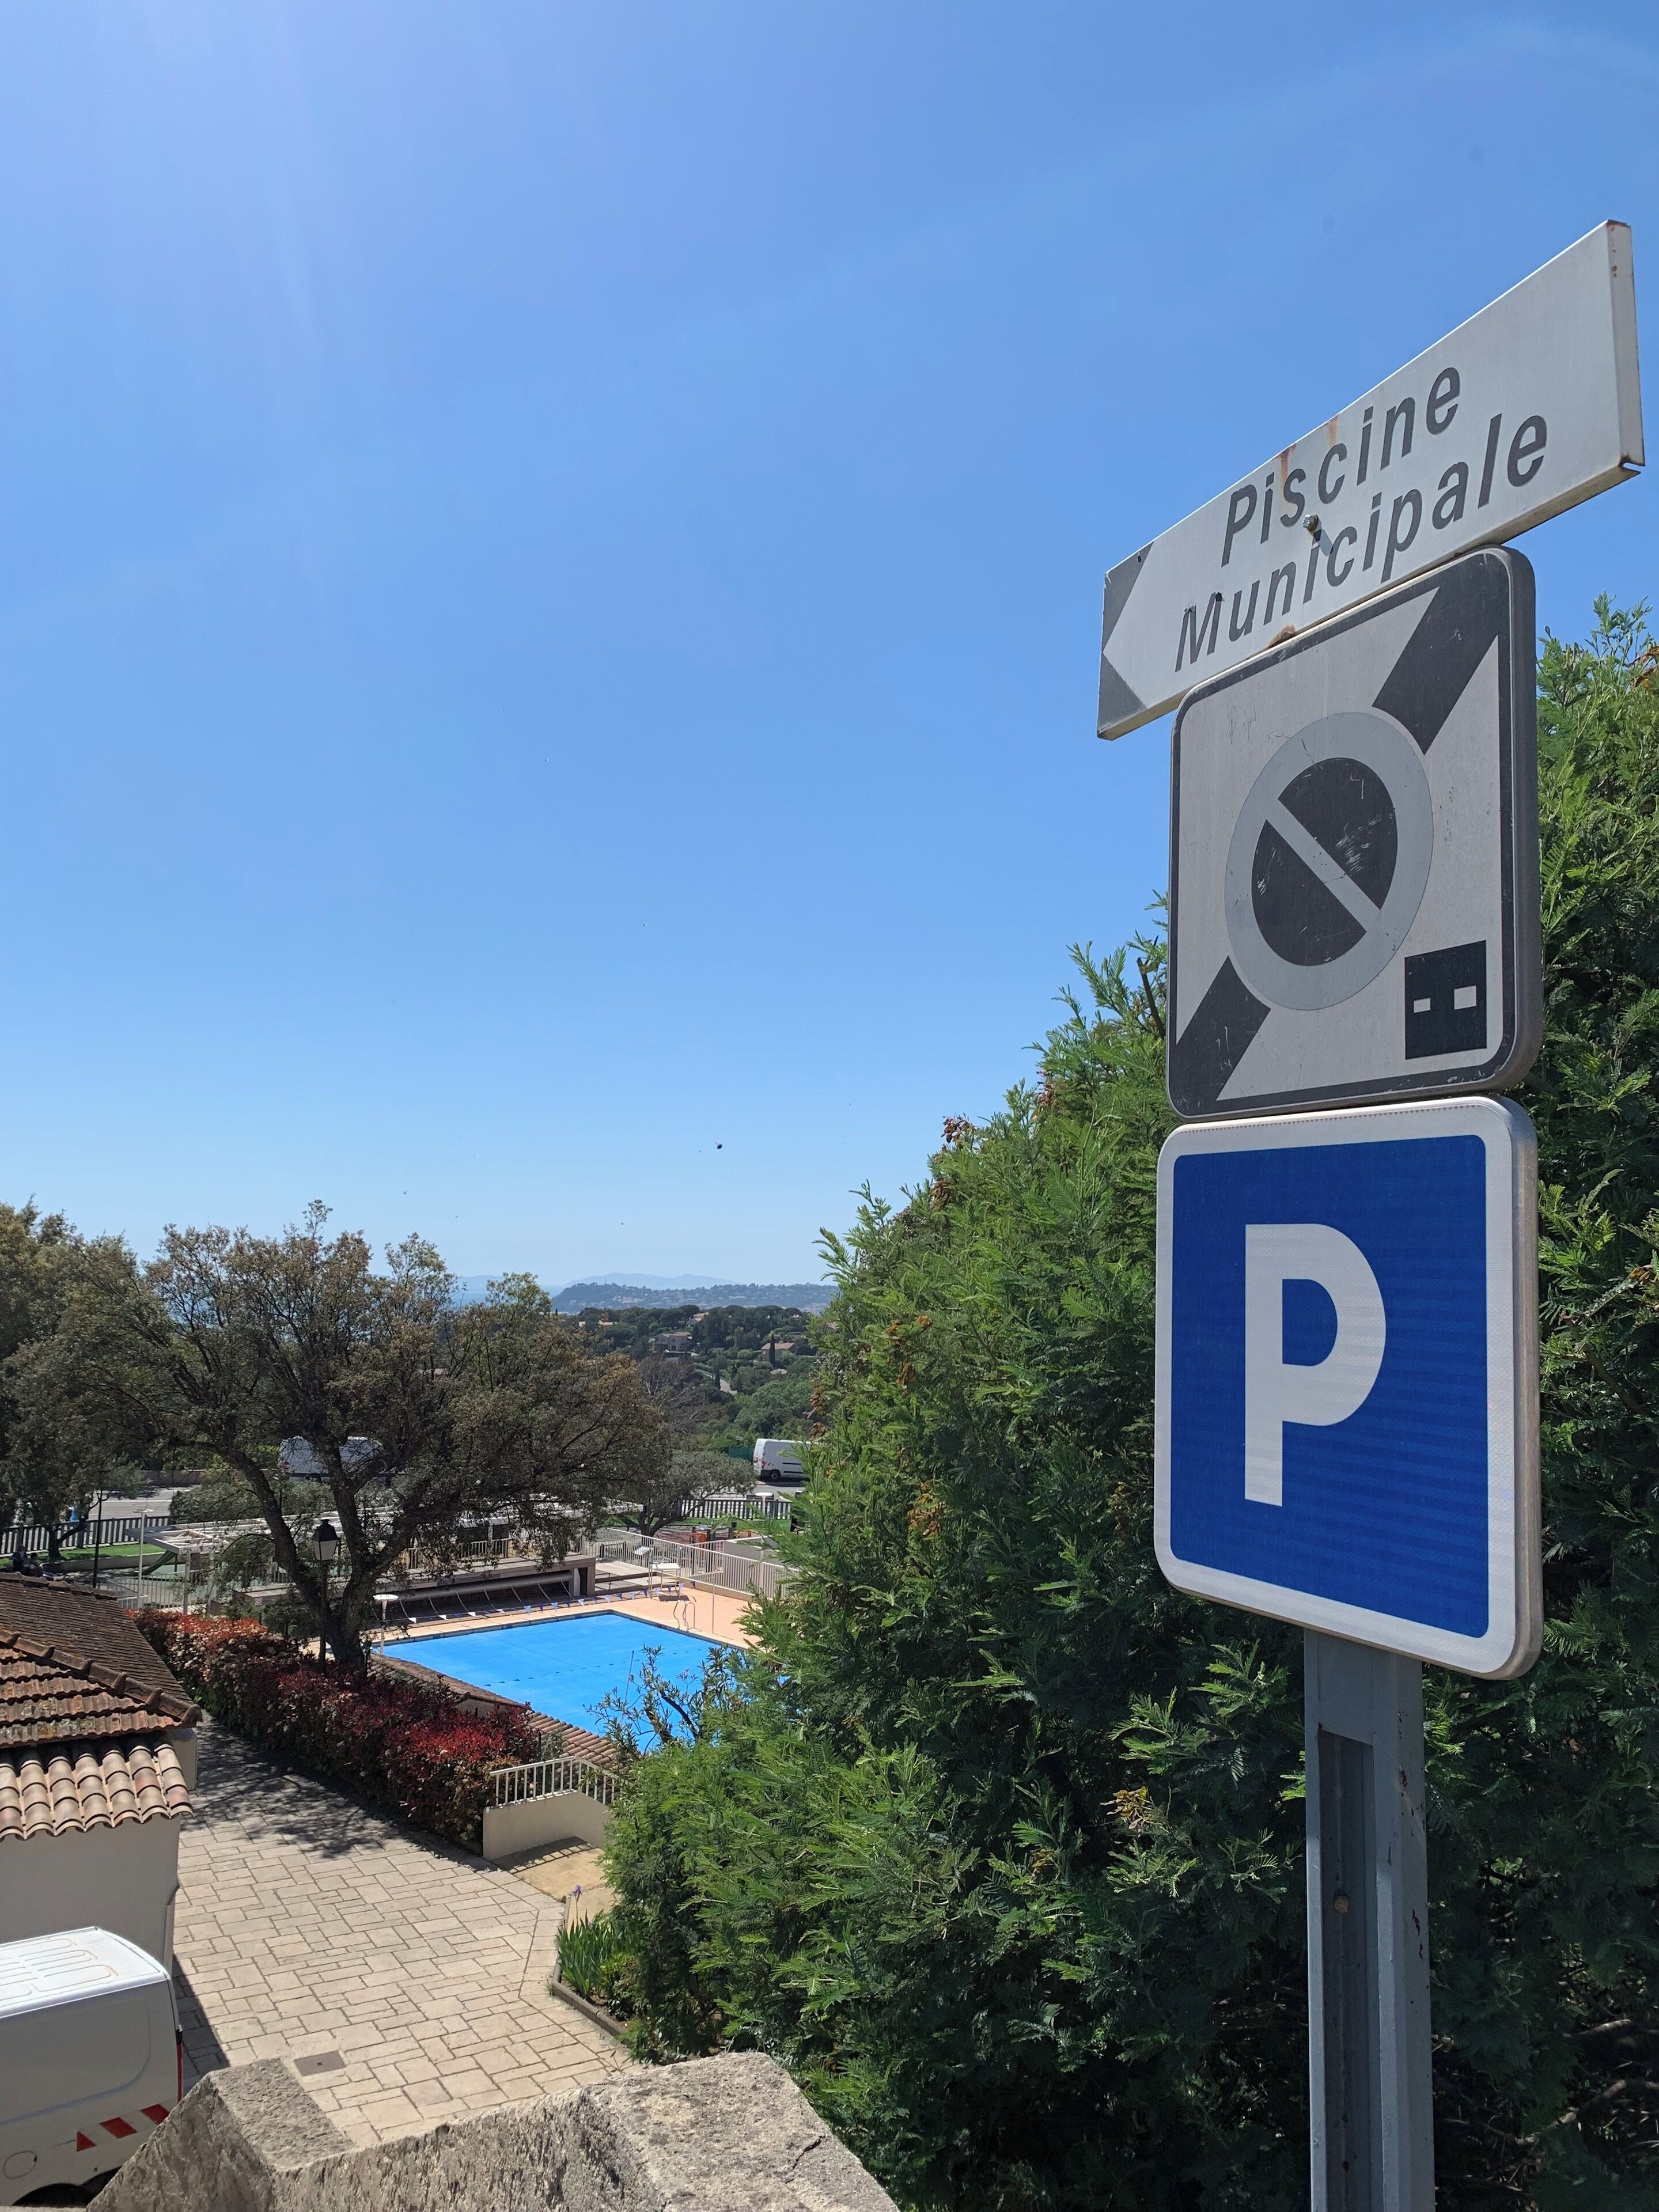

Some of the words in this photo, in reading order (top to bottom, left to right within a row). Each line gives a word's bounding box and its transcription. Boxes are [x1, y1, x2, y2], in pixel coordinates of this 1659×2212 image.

[1175, 413, 1547, 673] Municipale
[1221, 367, 1460, 566] Piscine
[1245, 1224, 1385, 1506] P
